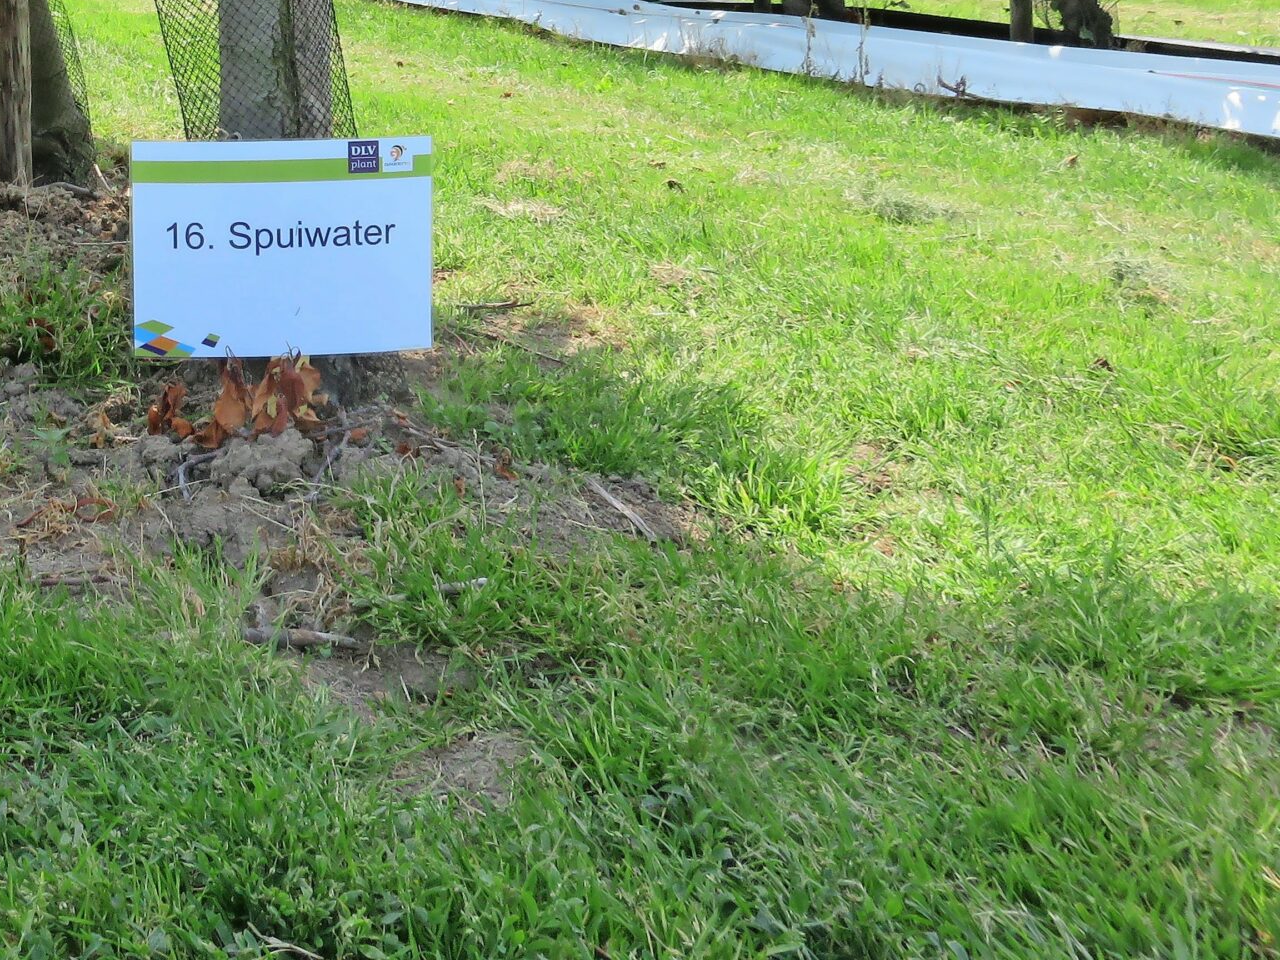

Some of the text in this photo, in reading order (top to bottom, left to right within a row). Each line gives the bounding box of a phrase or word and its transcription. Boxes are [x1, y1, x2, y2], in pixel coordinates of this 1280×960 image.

[351, 145, 376, 156] DLV
[351, 159, 376, 171] plant
[167, 220, 396, 257] 16. Spuiwater
